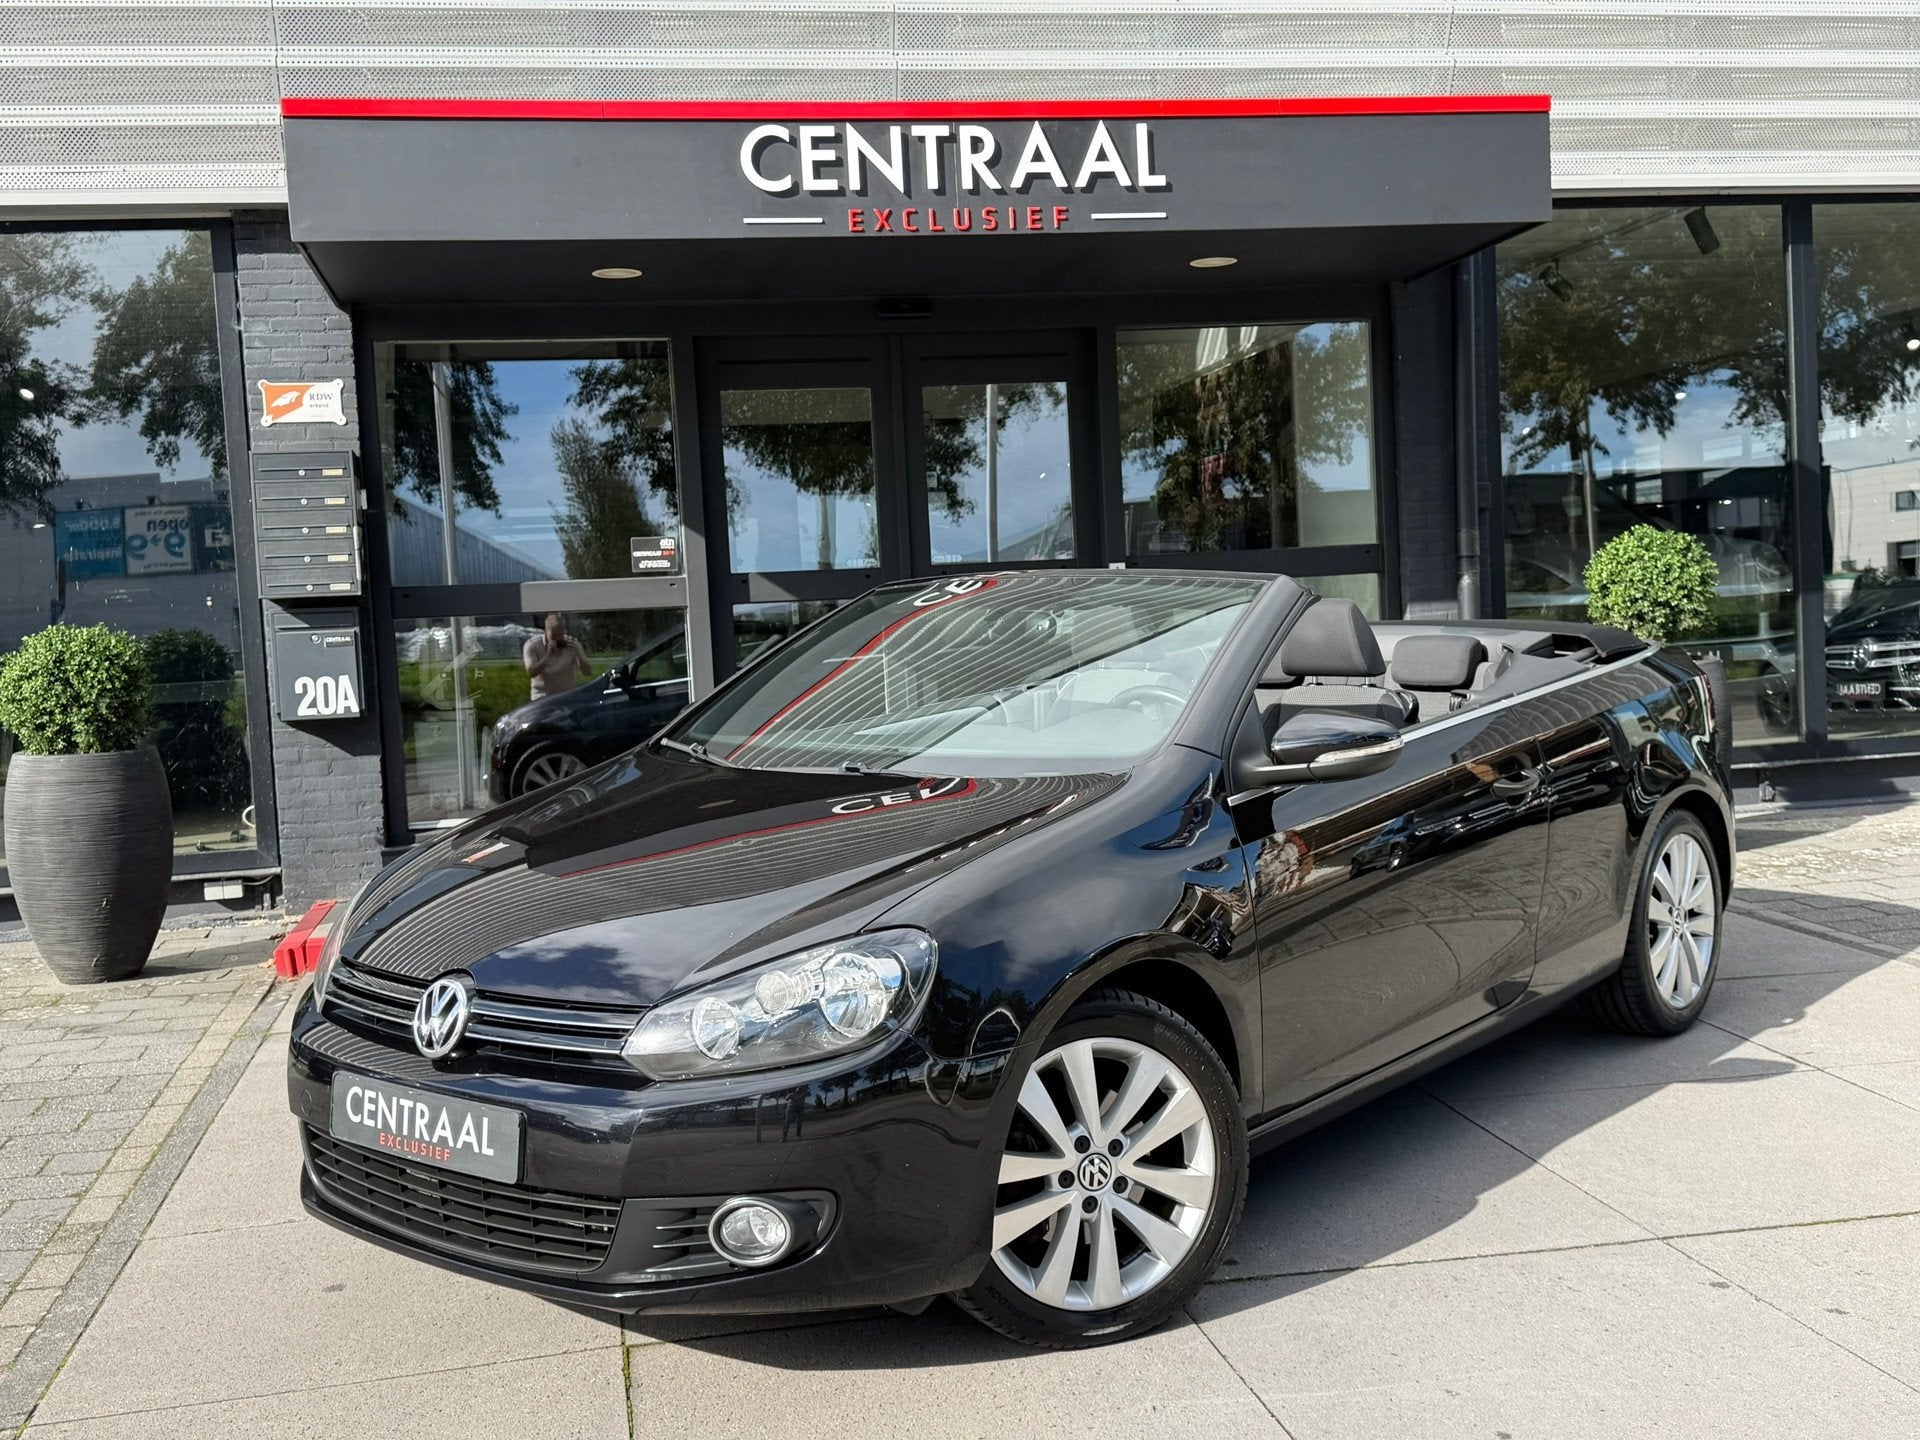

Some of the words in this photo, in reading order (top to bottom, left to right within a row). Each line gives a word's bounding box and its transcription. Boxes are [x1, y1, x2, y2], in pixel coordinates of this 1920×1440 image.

[739, 119, 1168, 194] CENTRAAL
[848, 206, 1070, 232] EXCLUSIEF
[309, 393, 333, 401] RDW
[294, 674, 360, 717] 20A
[346, 1085, 494, 1156] CENTRAAL
[379, 1132, 451, 1162] EXCLUSIEF
